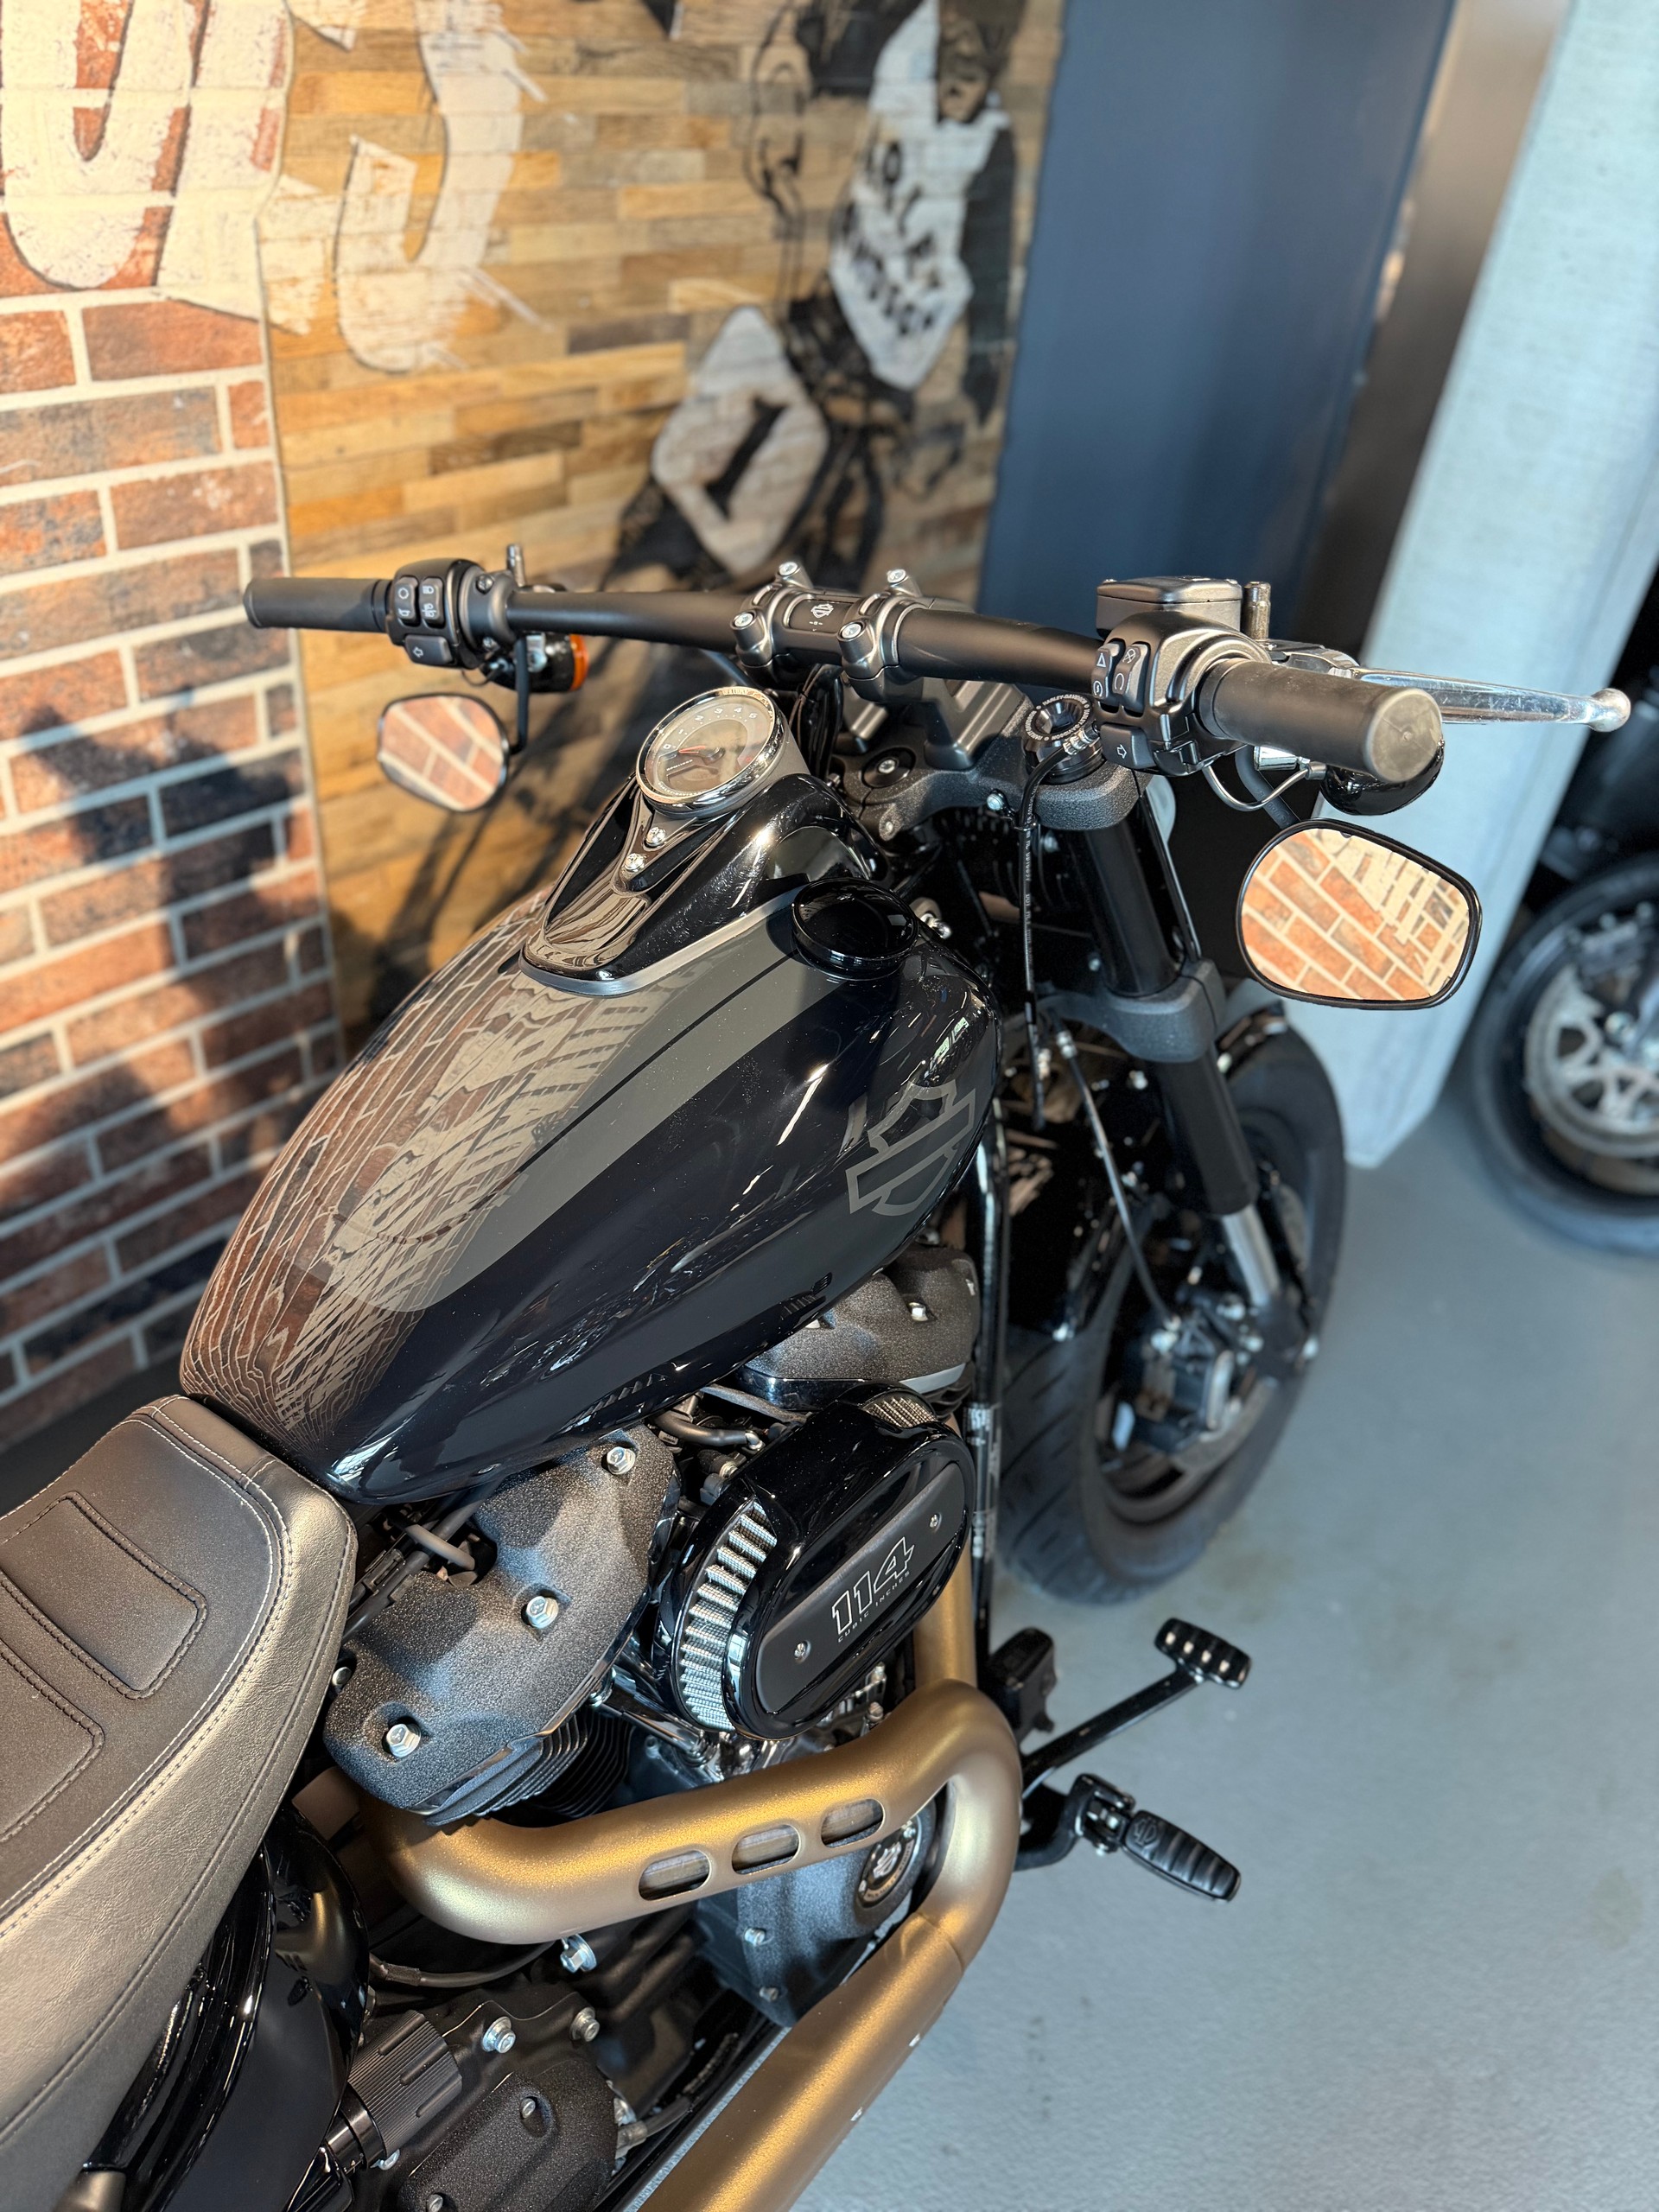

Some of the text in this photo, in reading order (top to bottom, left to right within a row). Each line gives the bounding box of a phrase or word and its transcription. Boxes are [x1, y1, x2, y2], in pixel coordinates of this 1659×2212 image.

[832, 1536, 915, 1635] 114
[837, 1570, 910, 1643] CUBIC INCHES
